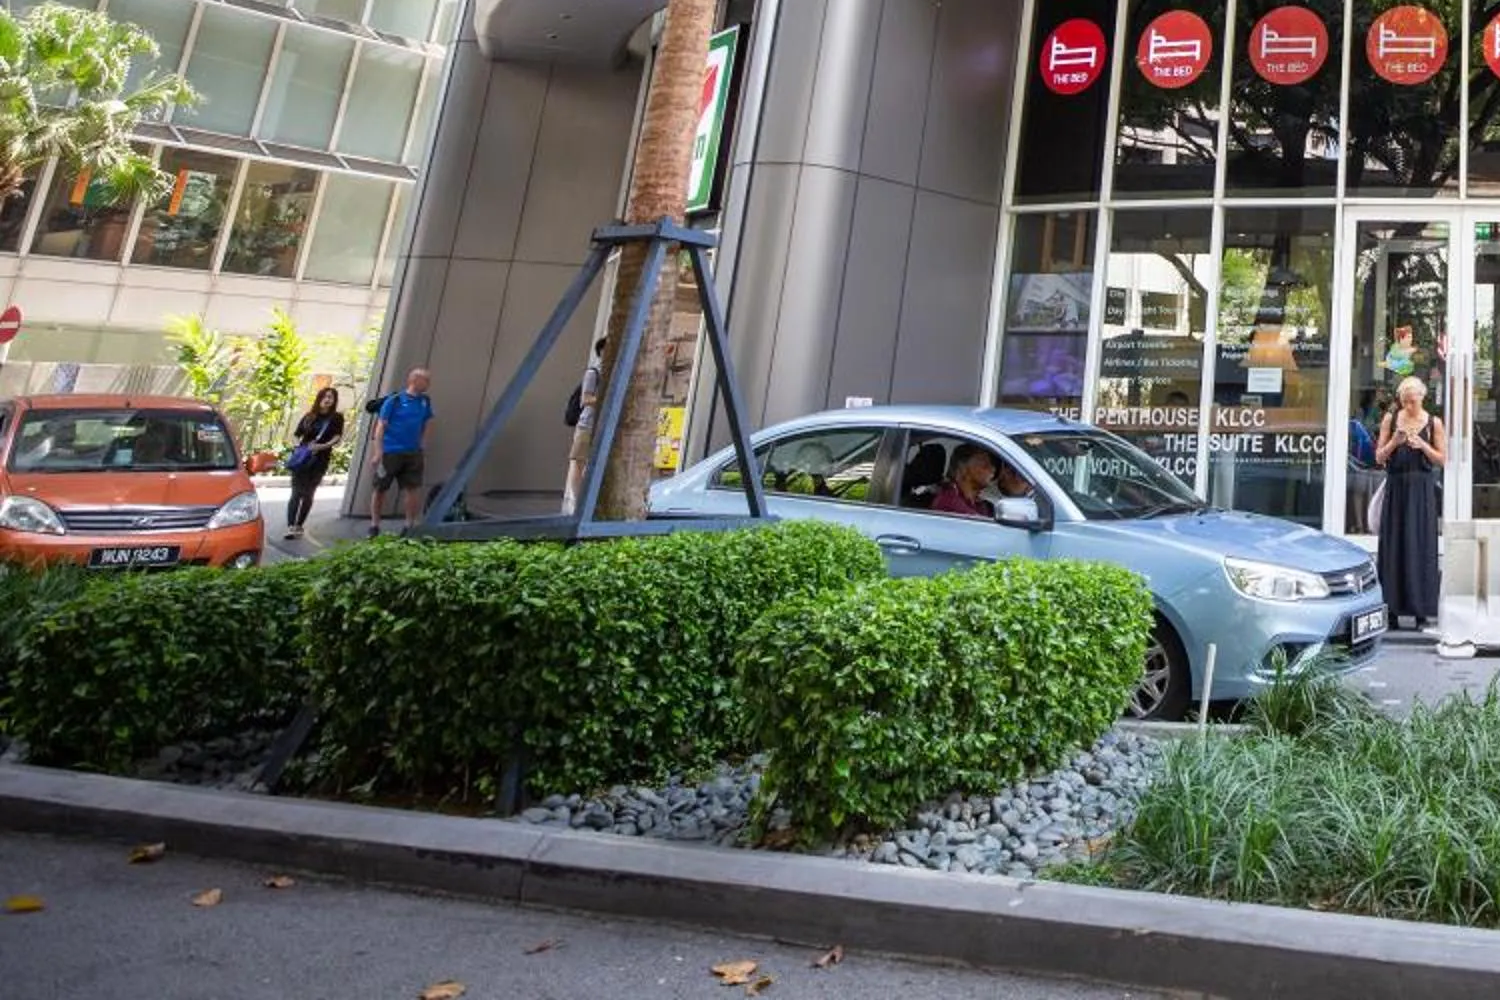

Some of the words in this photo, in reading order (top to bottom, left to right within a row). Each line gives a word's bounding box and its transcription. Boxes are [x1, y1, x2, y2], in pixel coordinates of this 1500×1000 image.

[1154, 66, 1171, 77] THE
[1173, 65, 1193, 76] BED
[1266, 62, 1286, 73] THE
[1288, 62, 1308, 73] BED
[1384, 62, 1404, 73] THE
[1407, 62, 1427, 73] BED
[1053, 73, 1069, 84] THE
[1070, 73, 1087, 83] BED
[1095, 406, 1199, 425] PENTHOUSE
[1216, 407, 1265, 427] KLCC
[1163, 433, 1198, 453] THE
[1209, 433, 1264, 453] SUITE
[1275, 434, 1325, 454] KLCC
